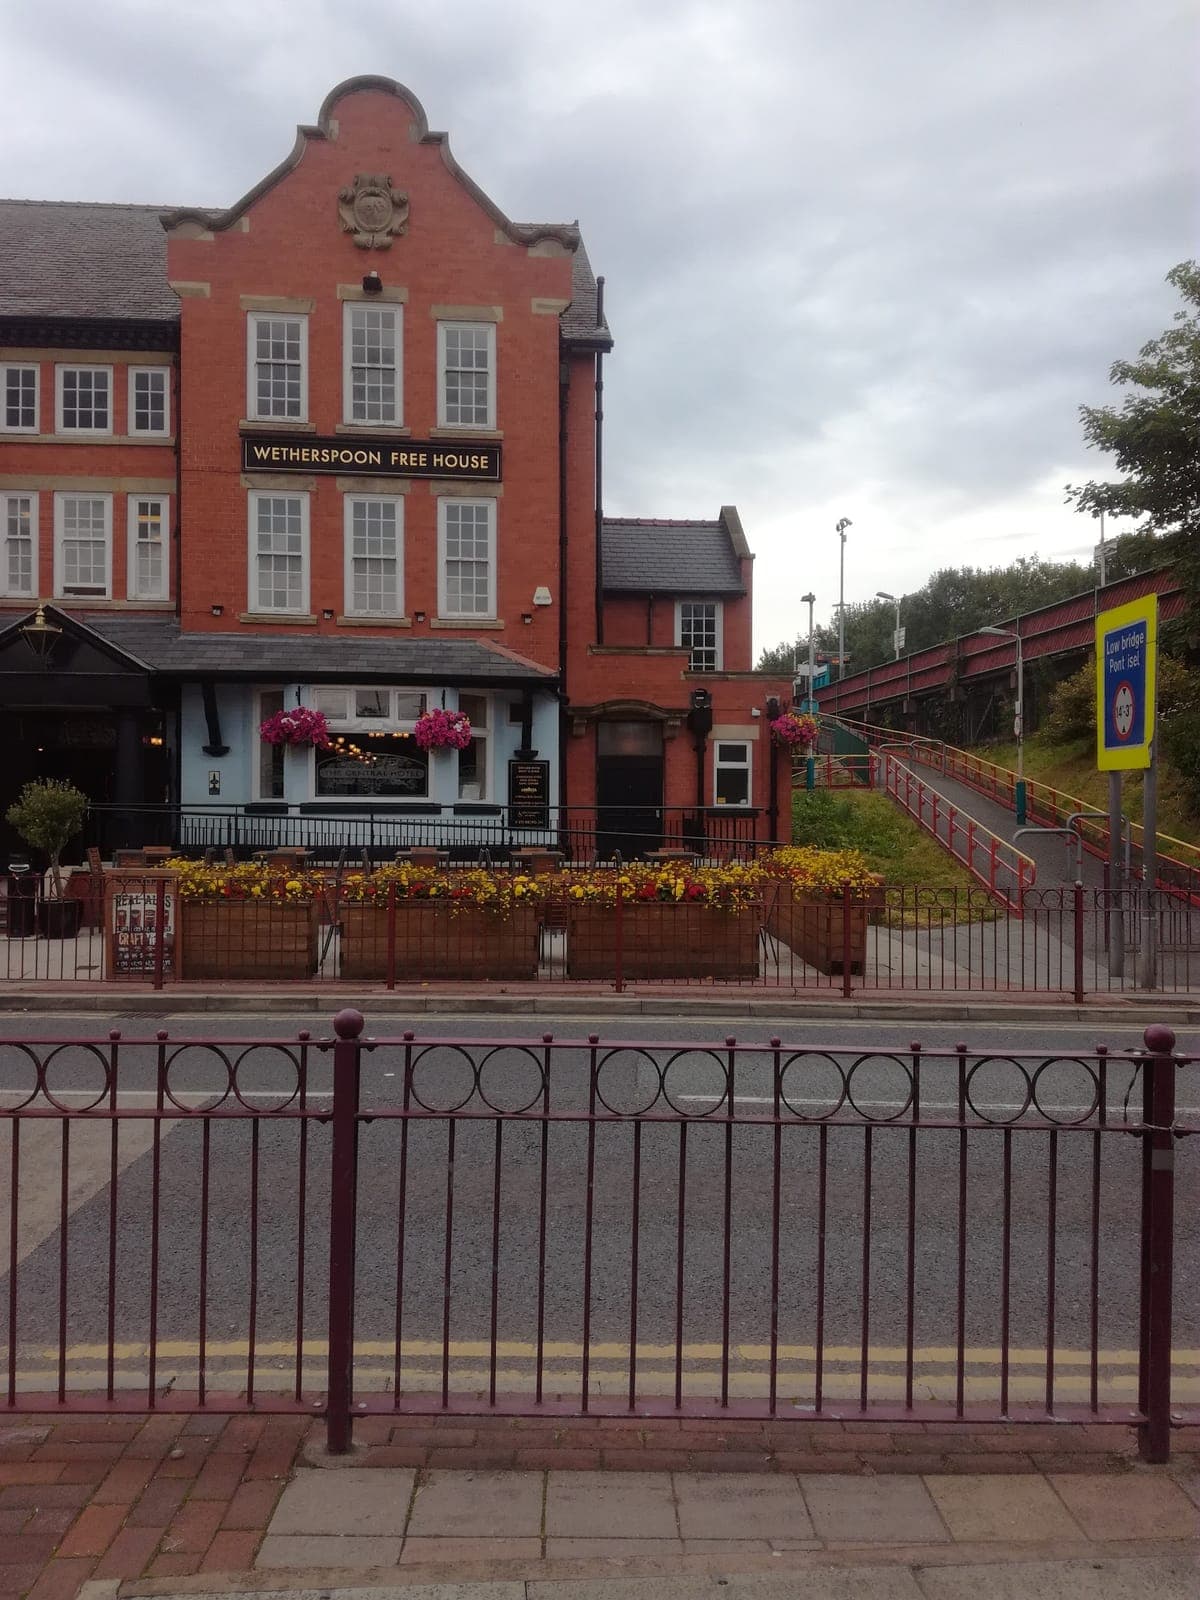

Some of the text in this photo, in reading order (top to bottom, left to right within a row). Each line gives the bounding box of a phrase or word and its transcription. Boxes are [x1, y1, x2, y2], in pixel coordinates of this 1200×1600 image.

[253, 446, 489, 469] WETHERSPOON FREE HOUSE
[1106, 631, 1145, 655] Low bridge
[1109, 650, 1140, 673] Pont isel
[115, 894, 171, 908] REAL ALS
[118, 932, 144, 945] CRAFT
